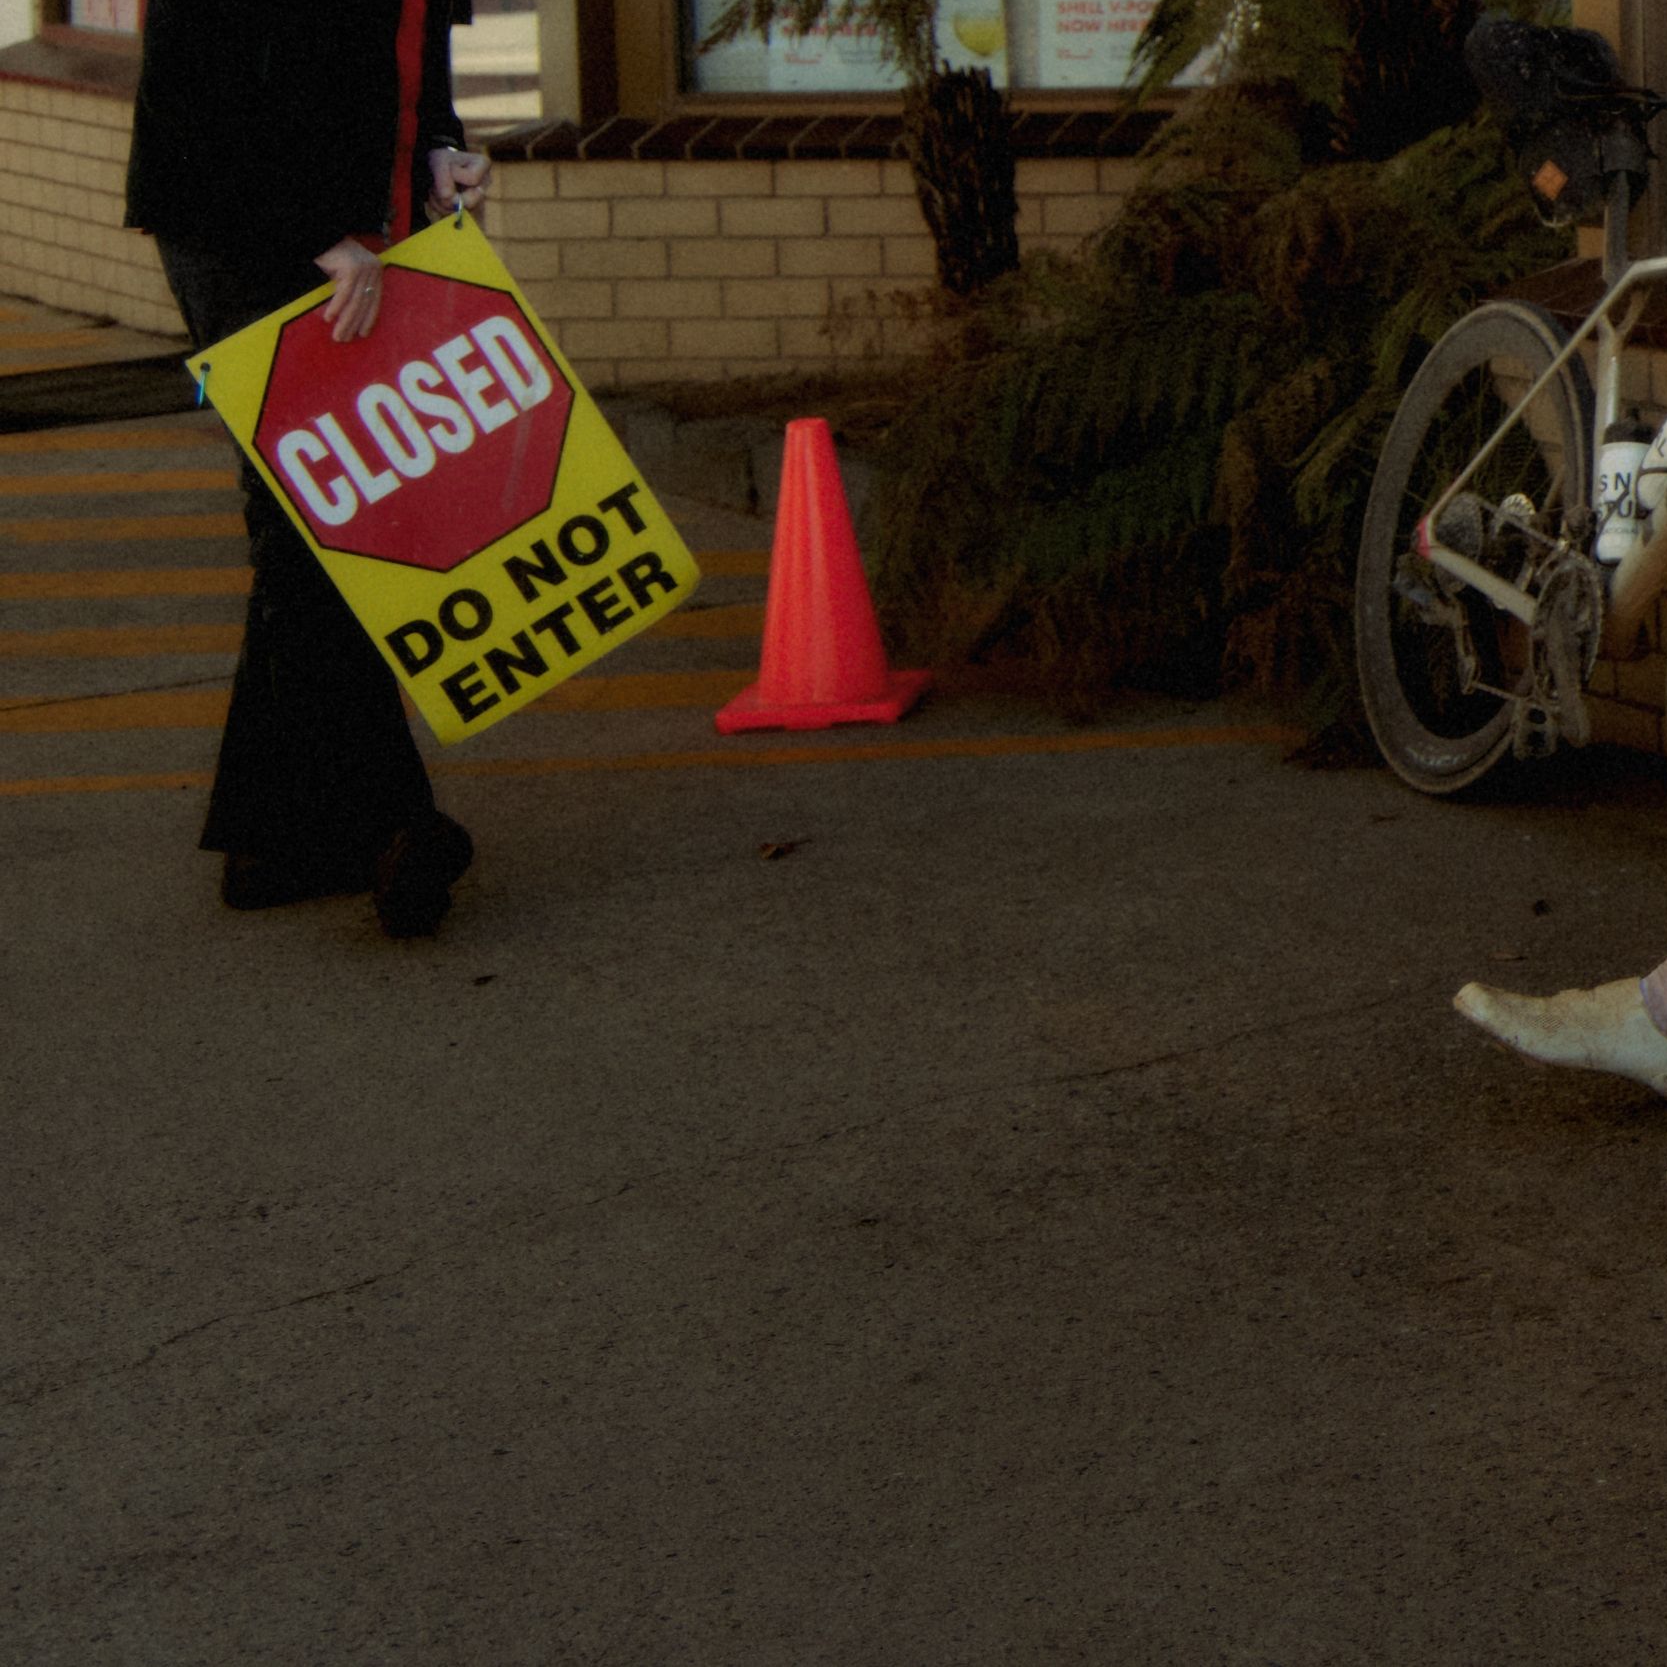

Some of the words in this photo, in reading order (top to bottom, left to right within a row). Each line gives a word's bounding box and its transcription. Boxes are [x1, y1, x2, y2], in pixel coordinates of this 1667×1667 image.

[1056, 0, 1104, 15] SHELL
[1057, 19, 1101, 32] NOW
[275, 315, 554, 527] CLOSED
[384, 588, 494, 679] DO
[502, 481, 651, 605] NOT
[440, 550, 680, 724] ENTER
